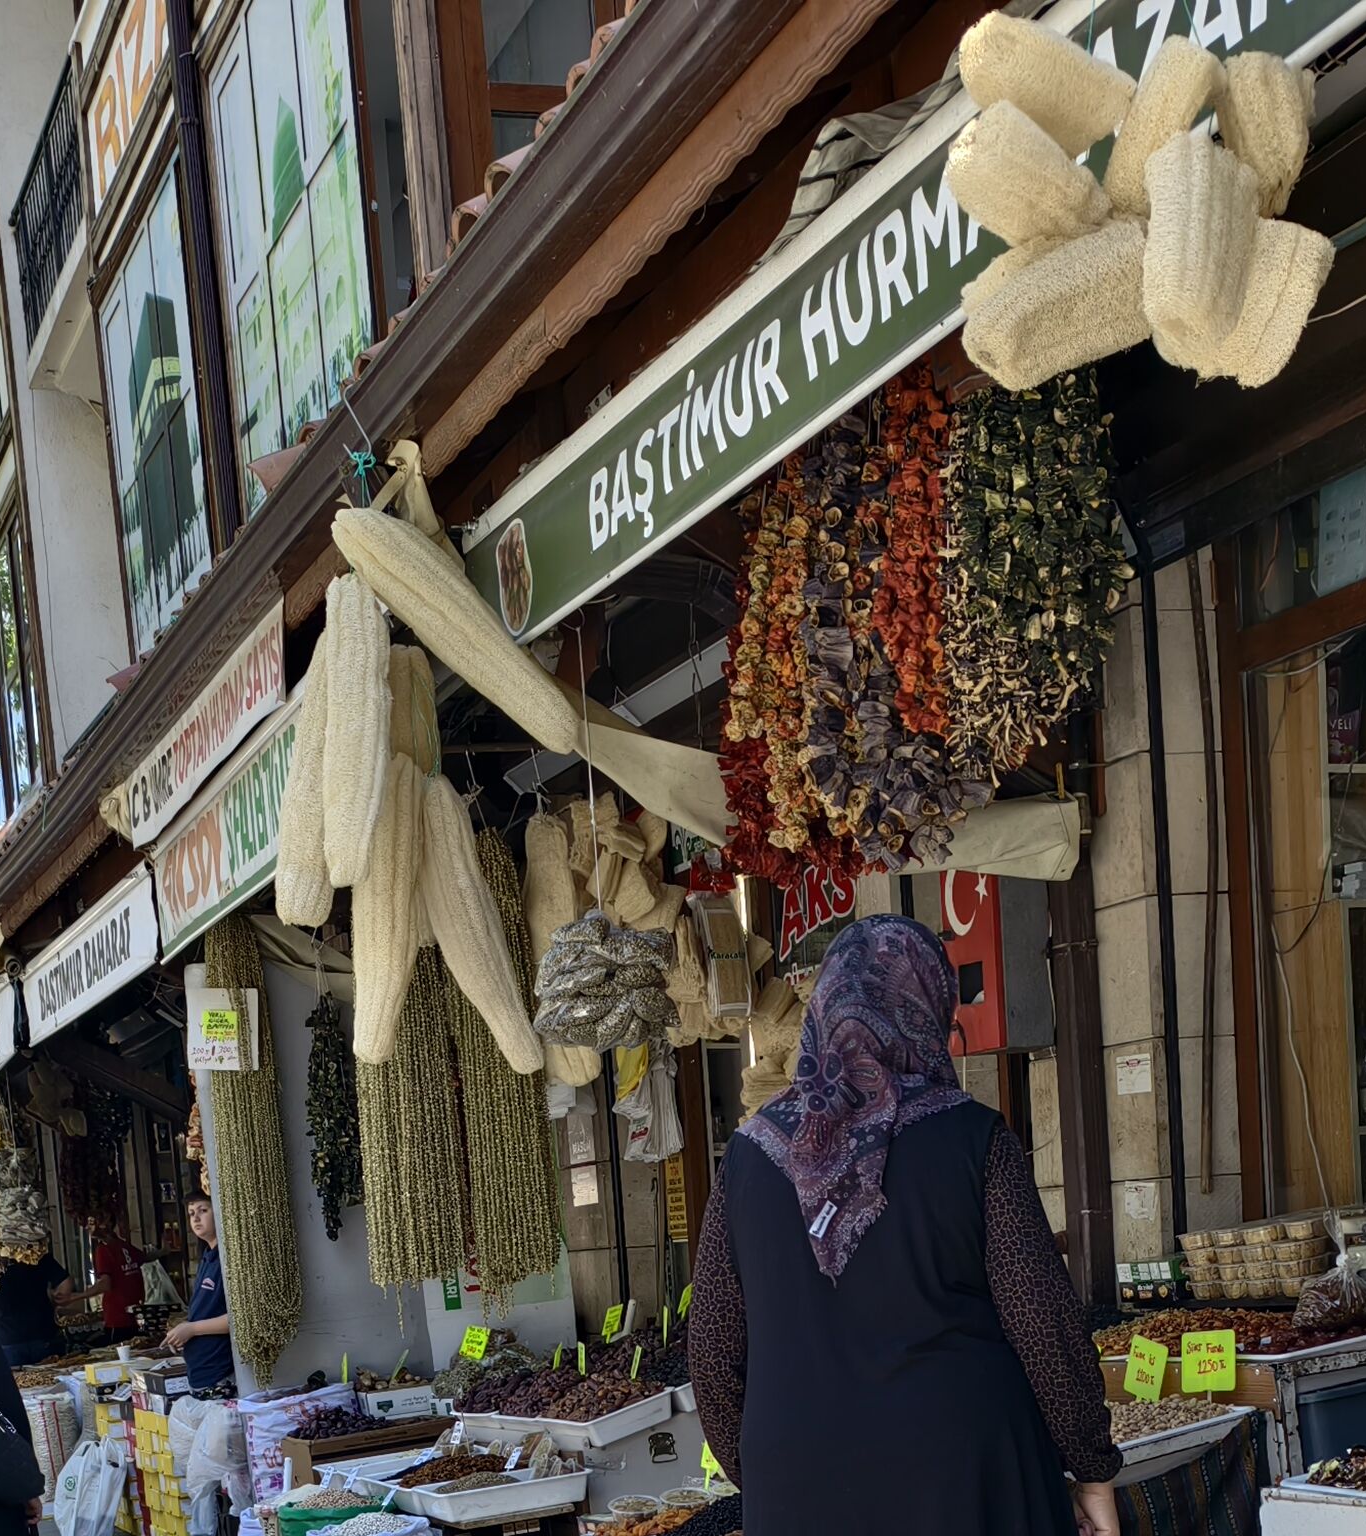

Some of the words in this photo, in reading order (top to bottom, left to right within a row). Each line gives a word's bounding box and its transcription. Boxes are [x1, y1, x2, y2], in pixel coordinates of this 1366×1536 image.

[588, 318, 730, 552] BAŞTİMUR
[173, 707, 210, 789] TOPTAN
[162, 802, 222, 921] AKSOY
[38, 949, 85, 1027] BAŞTİMUR
[84, 906, 131, 989] BAHARAT
